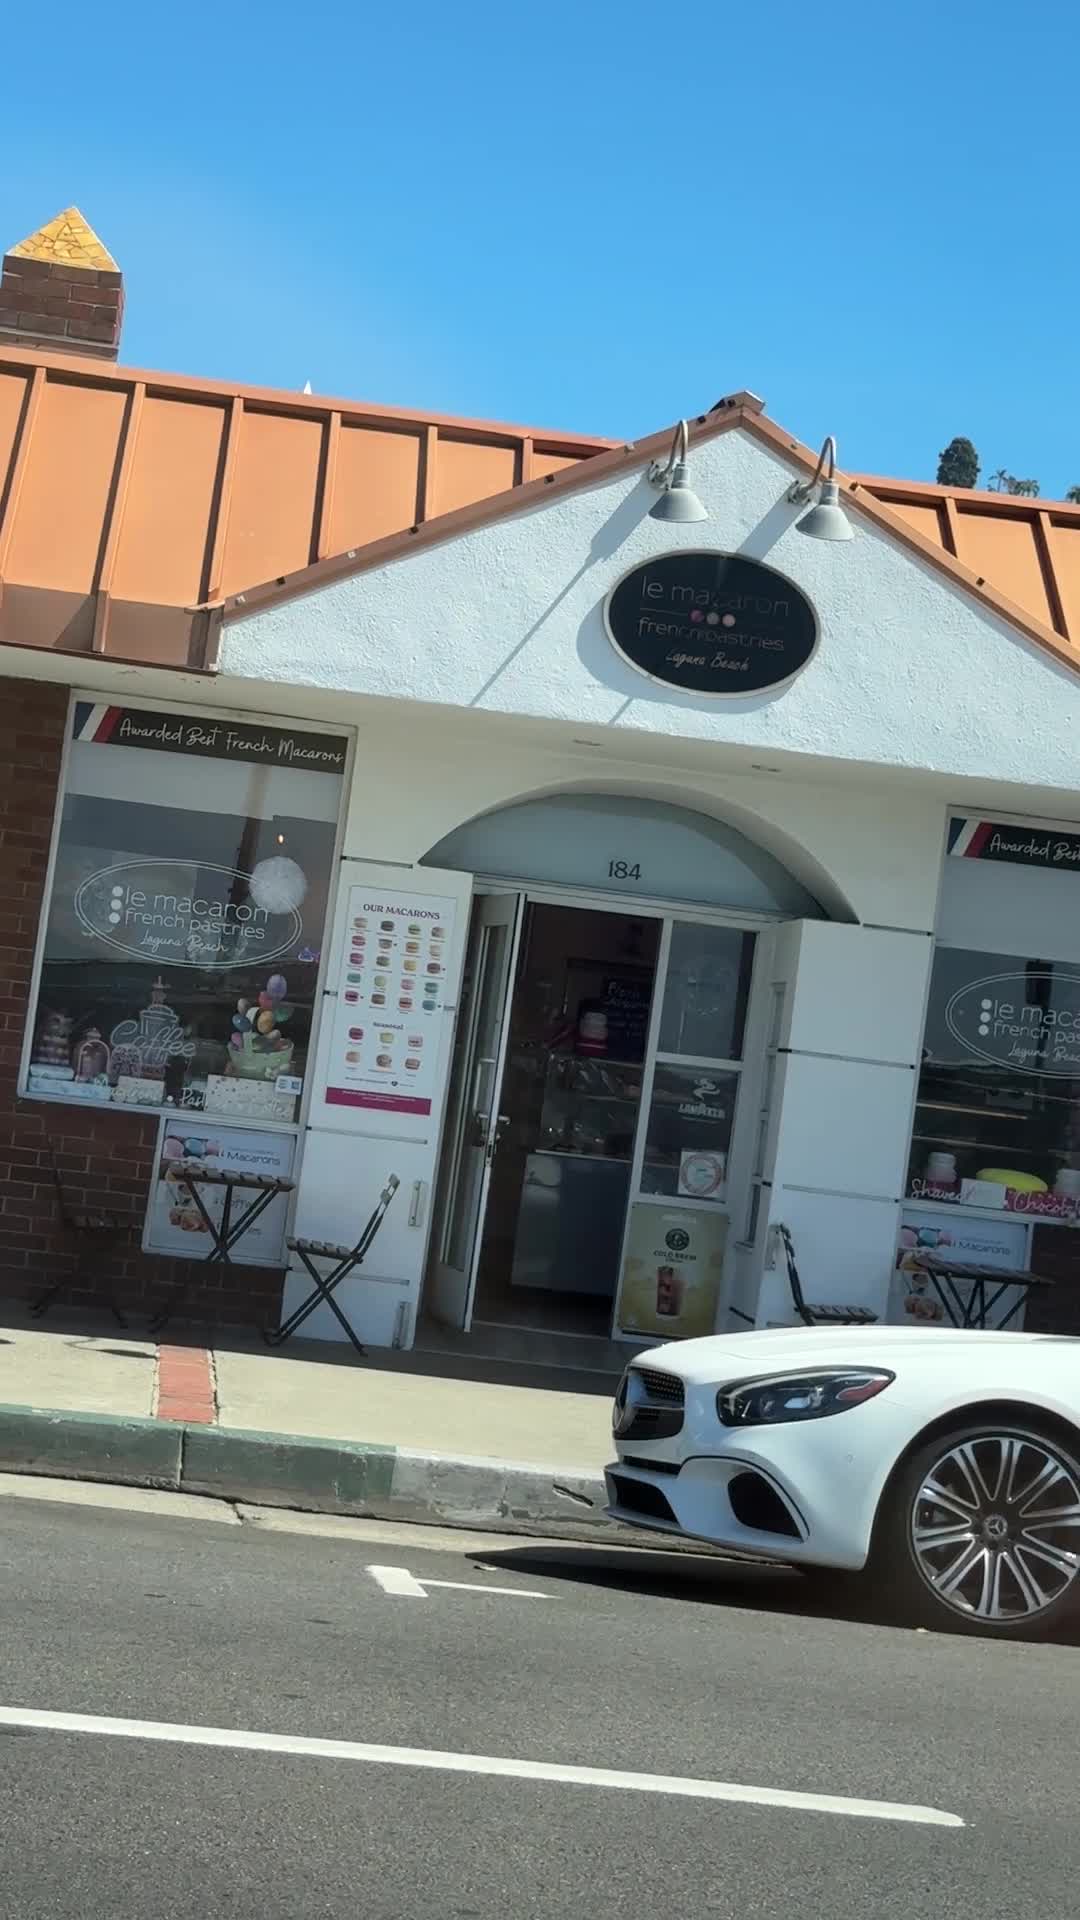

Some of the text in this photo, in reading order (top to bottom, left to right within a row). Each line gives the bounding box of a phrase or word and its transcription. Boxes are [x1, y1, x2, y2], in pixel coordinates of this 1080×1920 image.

[641, 575, 664, 599] le
[665, 648, 750, 671] Laguna Beach
[119, 717, 344, 763] Awarded Best French Macarons
[989, 832, 1051, 860] Awarded
[608, 860, 641, 881] 184
[125, 887, 270, 924] le macaron
[363, 903, 440, 920] OUR MACARONS
[125, 907, 266, 940] french pastries
[140, 929, 229, 953] Laguna Beach
[993, 999, 1014, 1020] le
[110, 1020, 196, 1062] Coffee
[993, 1019, 1052, 1040] french
[1007, 1039, 1050, 1065] Laguna
[226, 1151, 281, 1166] Macarons
